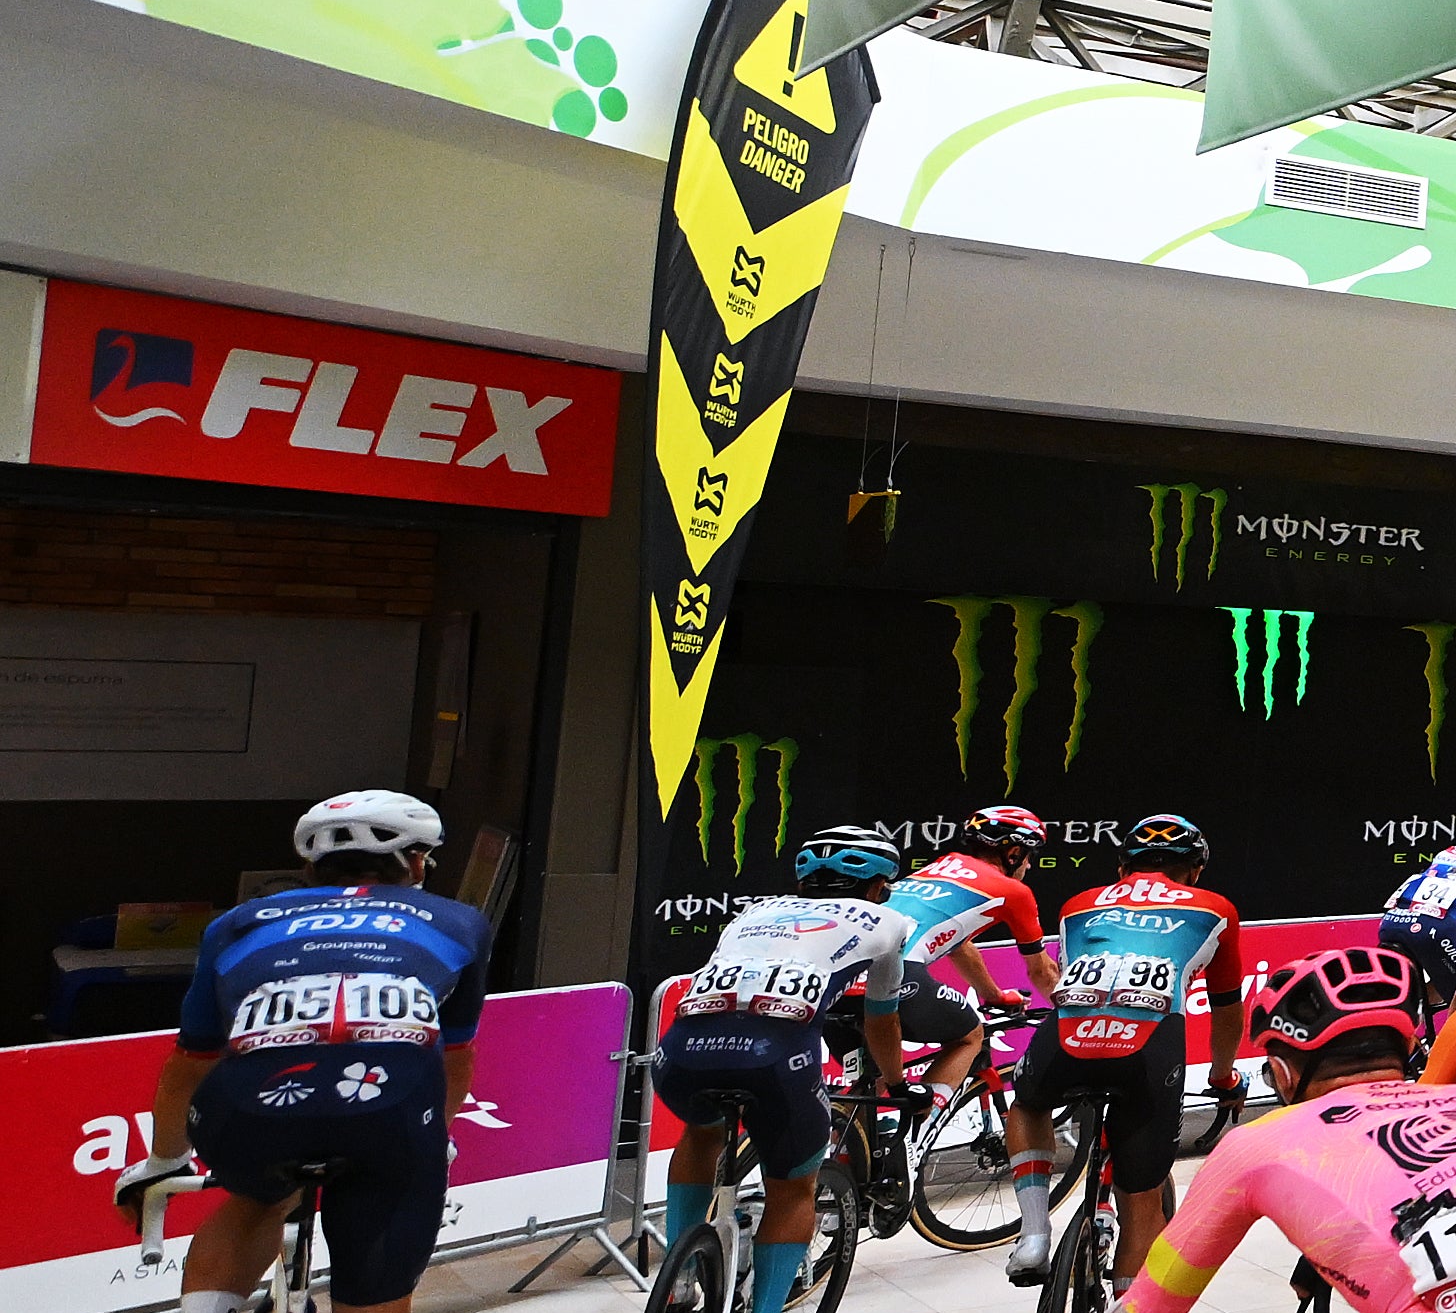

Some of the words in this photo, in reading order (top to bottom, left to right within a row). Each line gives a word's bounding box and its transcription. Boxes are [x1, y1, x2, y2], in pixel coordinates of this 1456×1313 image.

[743, 107, 810, 165] PELIGRO
[740, 139, 807, 193] DANGER
[201, 348, 573, 476] FLEX
[1266, 547, 1397, 566] ENERGY
[1422, 885, 1450, 905] 34
[255, 897, 433, 923] Groupama
[287, 914, 364, 936] FDJ
[303, 939, 387, 953] Groupama
[763, 964, 822, 1004] 138
[1063, 958, 1107, 987] 98
[1128, 961, 1169, 990] 98
[242, 990, 330, 1031] 105
[352, 985, 437, 1027] 105
[686, 1037, 754, 1046] BAHRAIN
[1075, 1019, 1138, 1041] CAPS
[1270, 1015, 1308, 1043] POC
